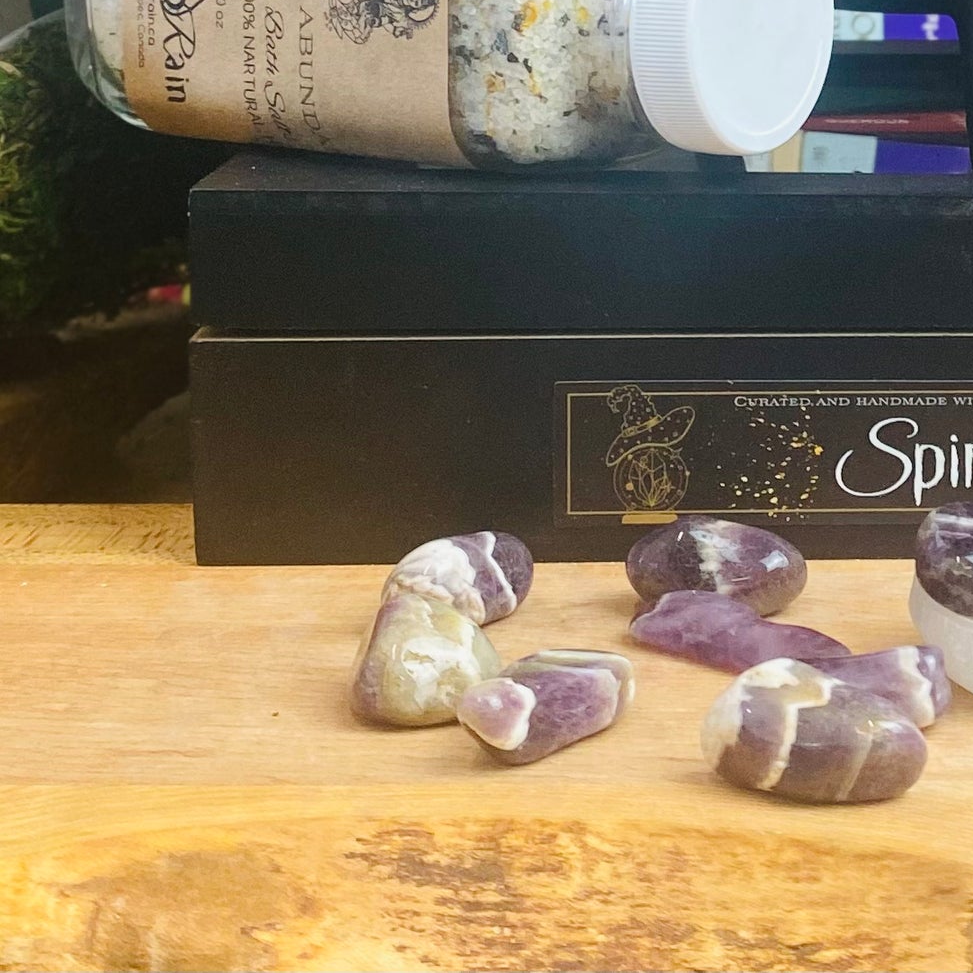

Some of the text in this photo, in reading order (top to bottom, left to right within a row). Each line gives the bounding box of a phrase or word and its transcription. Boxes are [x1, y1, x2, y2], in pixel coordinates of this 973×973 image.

[215, 10, 224, 29] oz
[264, 5, 285, 76] Bath
[856, 396, 948, 407] HANDMADE
